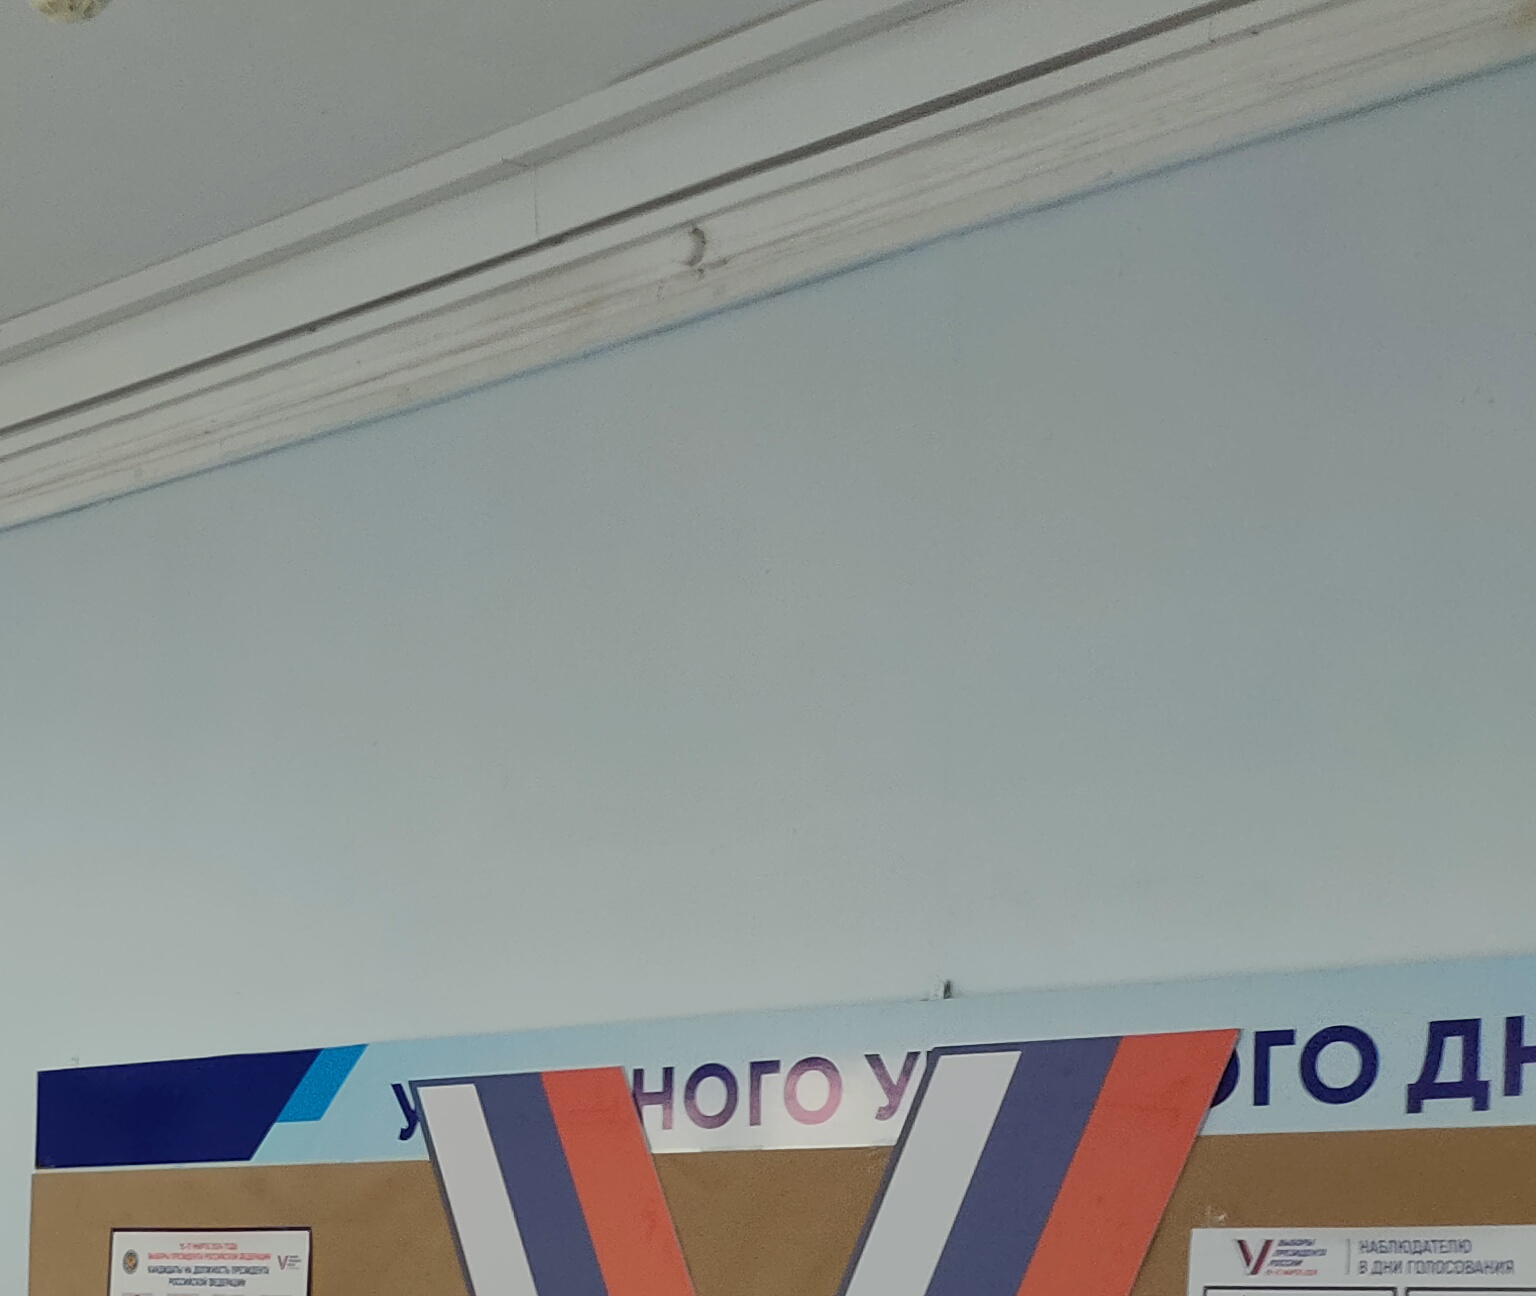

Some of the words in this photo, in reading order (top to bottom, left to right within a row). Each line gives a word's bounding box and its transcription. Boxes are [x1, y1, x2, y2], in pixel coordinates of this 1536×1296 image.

[1358, 1238, 1473, 1256] НАБЛЮДАТЕЛЮ
[1358, 1260, 1368, 1275] В
[1371, 1260, 1404, 1276] ДНИ
[1407, 1260, 1516, 1276] ГОЛОСОВАНИЯ
